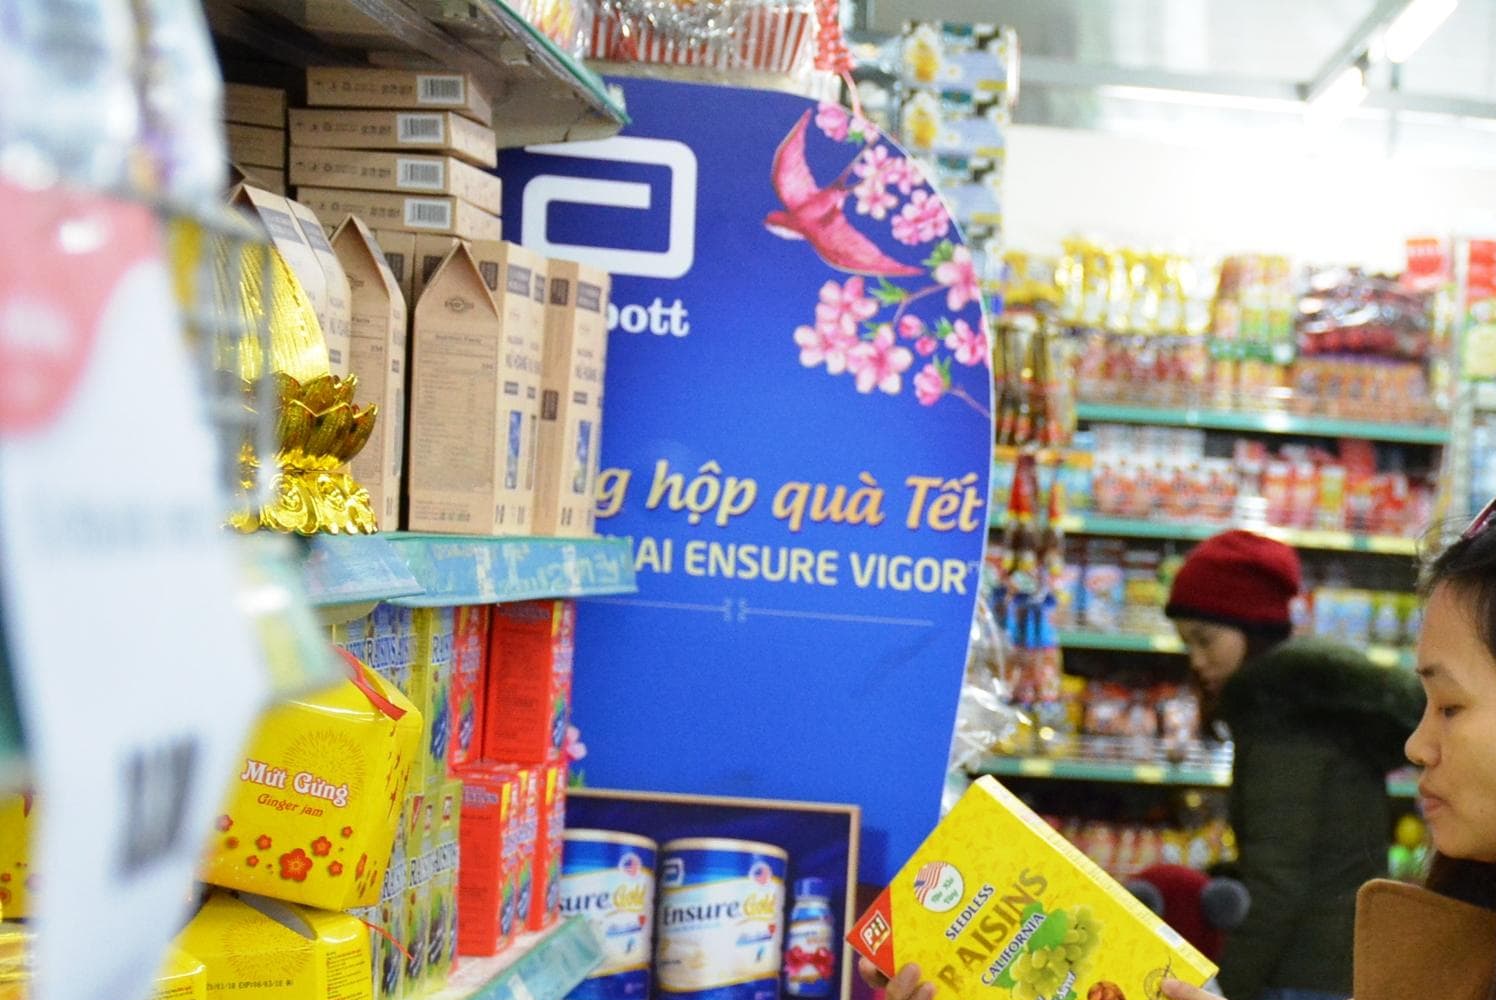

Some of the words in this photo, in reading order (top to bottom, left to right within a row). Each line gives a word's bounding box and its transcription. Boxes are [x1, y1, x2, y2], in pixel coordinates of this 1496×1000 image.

[646, 459, 758, 527] hộp
[772, 471, 885, 532] quà
[905, 472, 984, 533] Tết
[635, 537, 673, 574] AI
[684, 541, 839, 586] ENSURE
[850, 552, 968, 595] VIGOR
[257, 792, 299, 812] Ginger
[301, 805, 324, 818] jam
[293, 770, 349, 808] Gừng
[936, 867, 1049, 994] RAISINS
[944, 884, 995, 941] SEEDLESS
[980, 912, 1047, 987] CALIFORNIA
